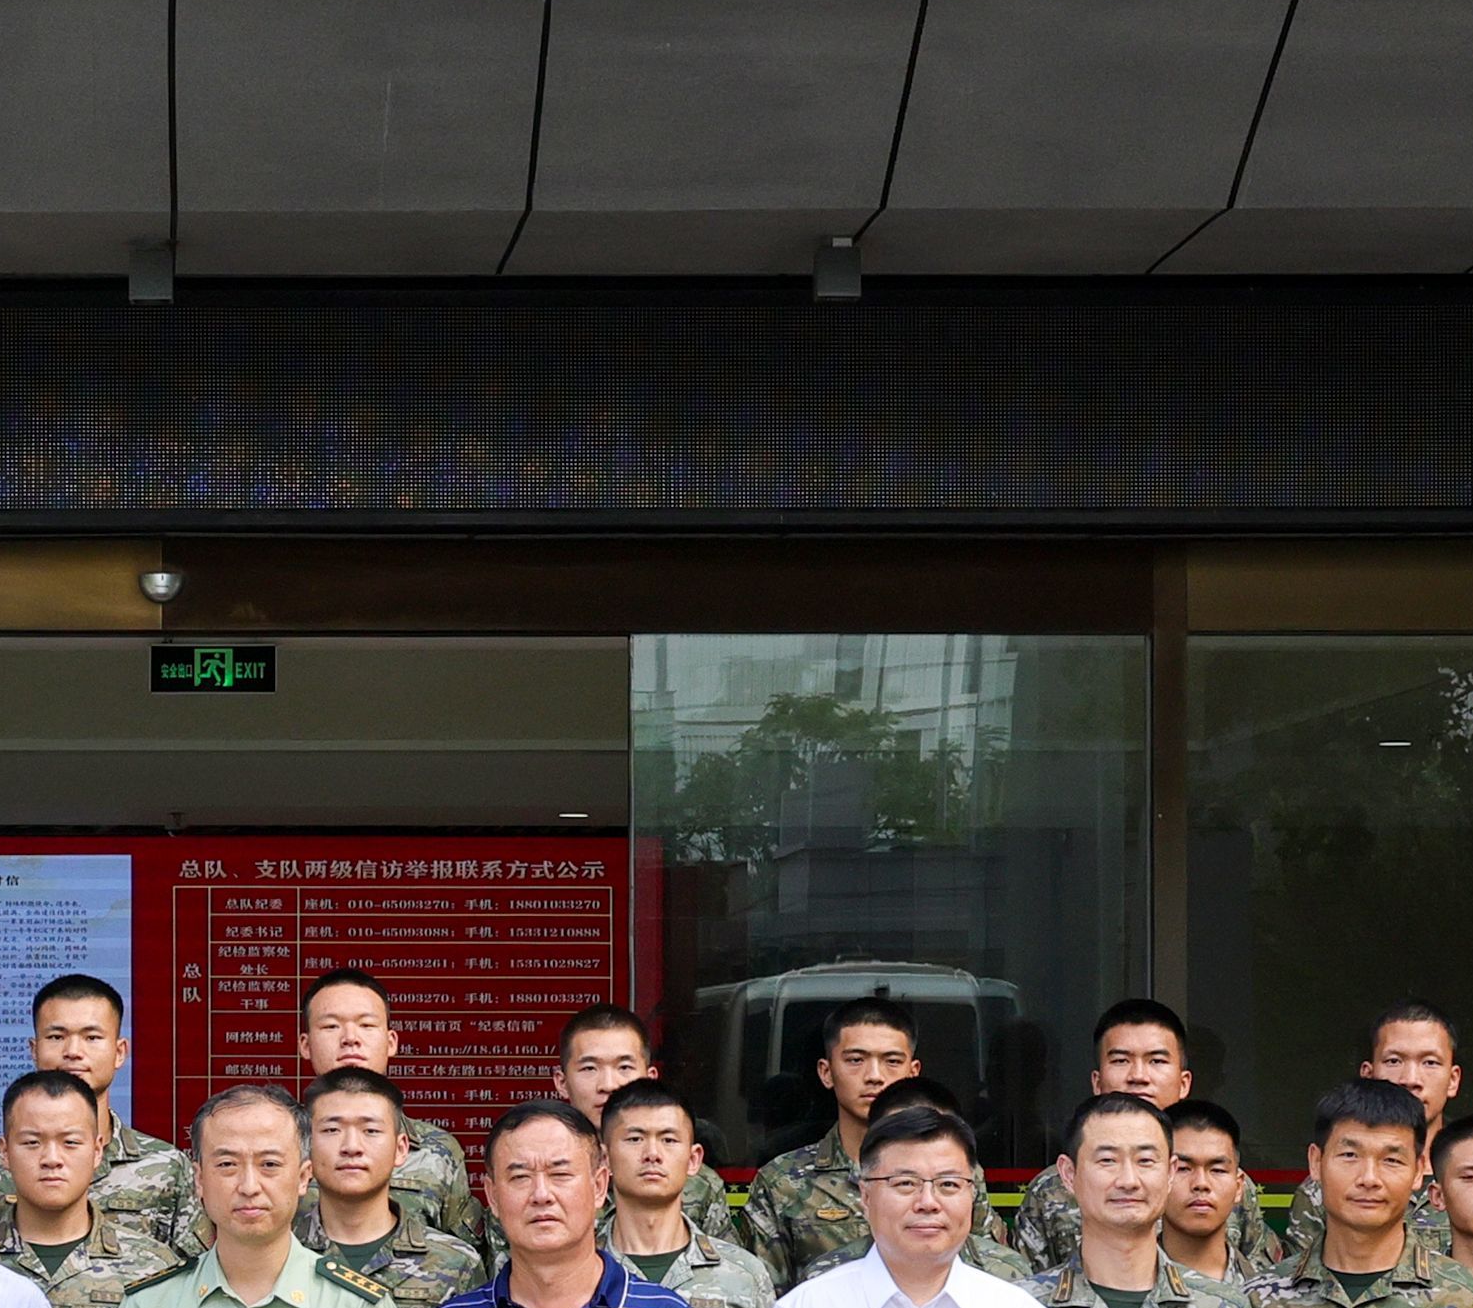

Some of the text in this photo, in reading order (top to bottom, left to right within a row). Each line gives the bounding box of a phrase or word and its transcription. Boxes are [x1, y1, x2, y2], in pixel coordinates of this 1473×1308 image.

[235, 662, 266, 679] EXIT
[179, 859, 605, 880] 总队、支队两级信访举报联系方式公示
[225, 927, 283, 939] 纪委书记
